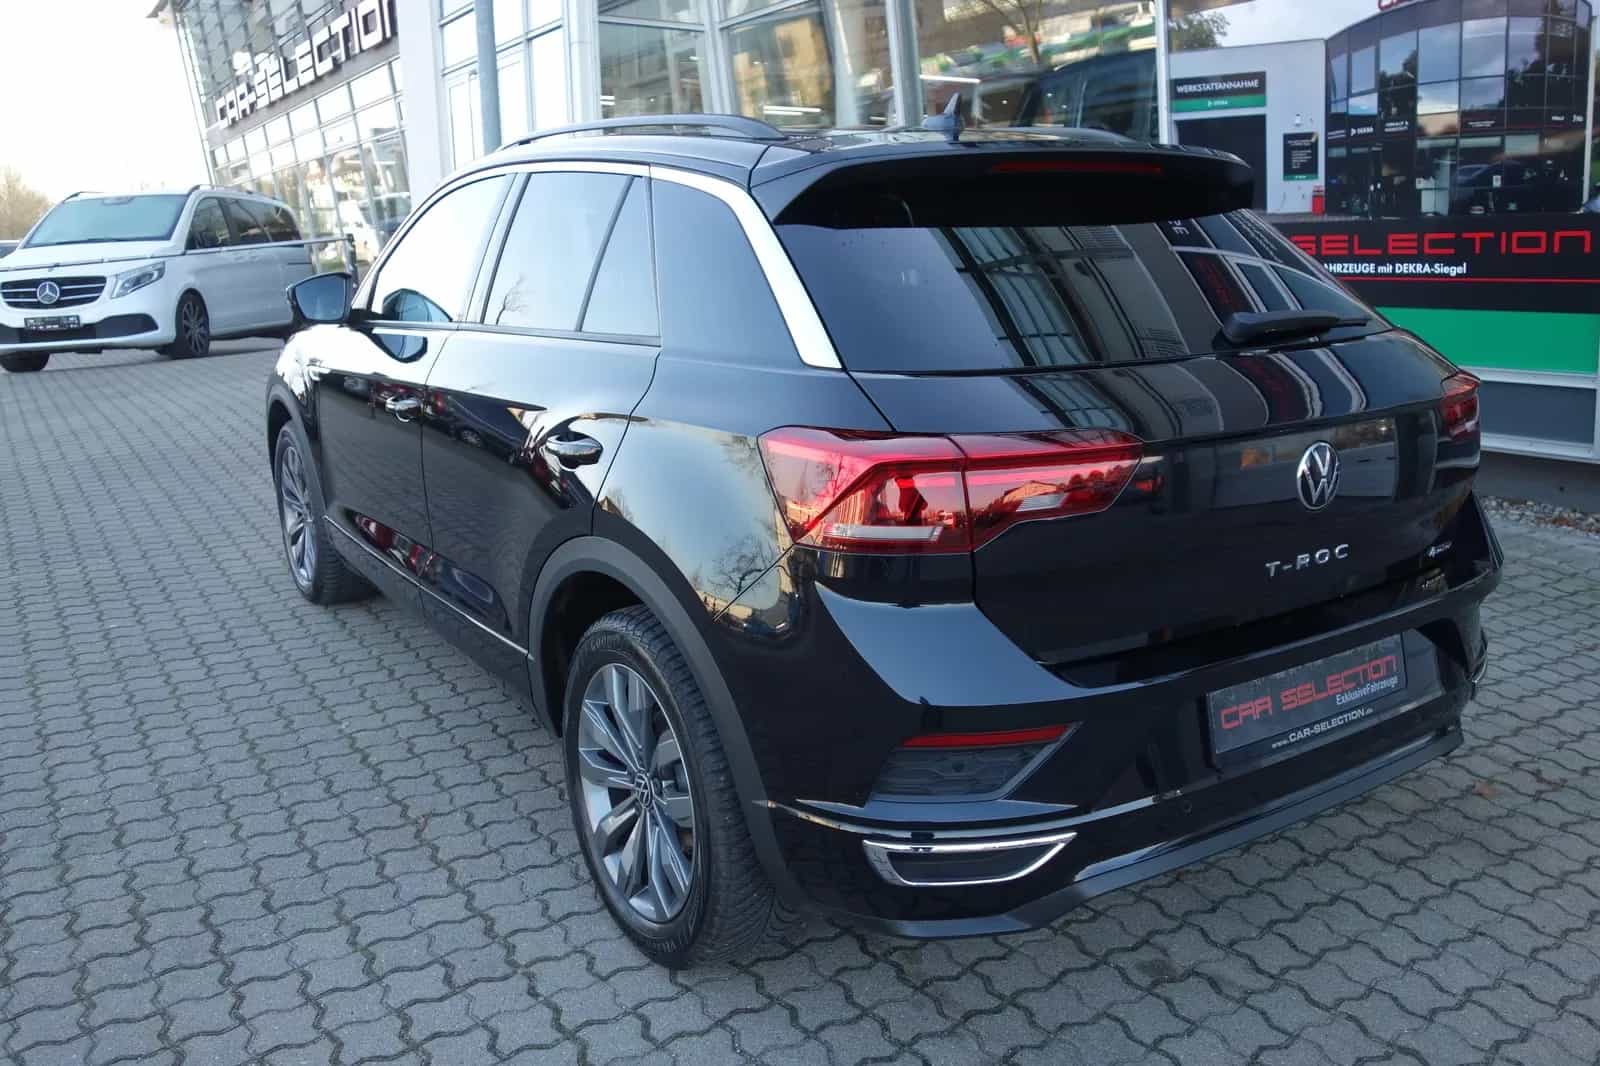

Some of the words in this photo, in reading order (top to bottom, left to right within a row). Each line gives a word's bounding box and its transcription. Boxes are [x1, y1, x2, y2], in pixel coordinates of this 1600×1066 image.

[1289, 230, 1592, 256] SELECTION
[1378, 263, 1393, 274] mit
[1395, 262, 1467, 277] DEKRA-Siegel
[1265, 543, 1349, 577] T-ROC
[1220, 695, 1273, 730] CAR
[1280, 655, 1399, 711] SELECTION
